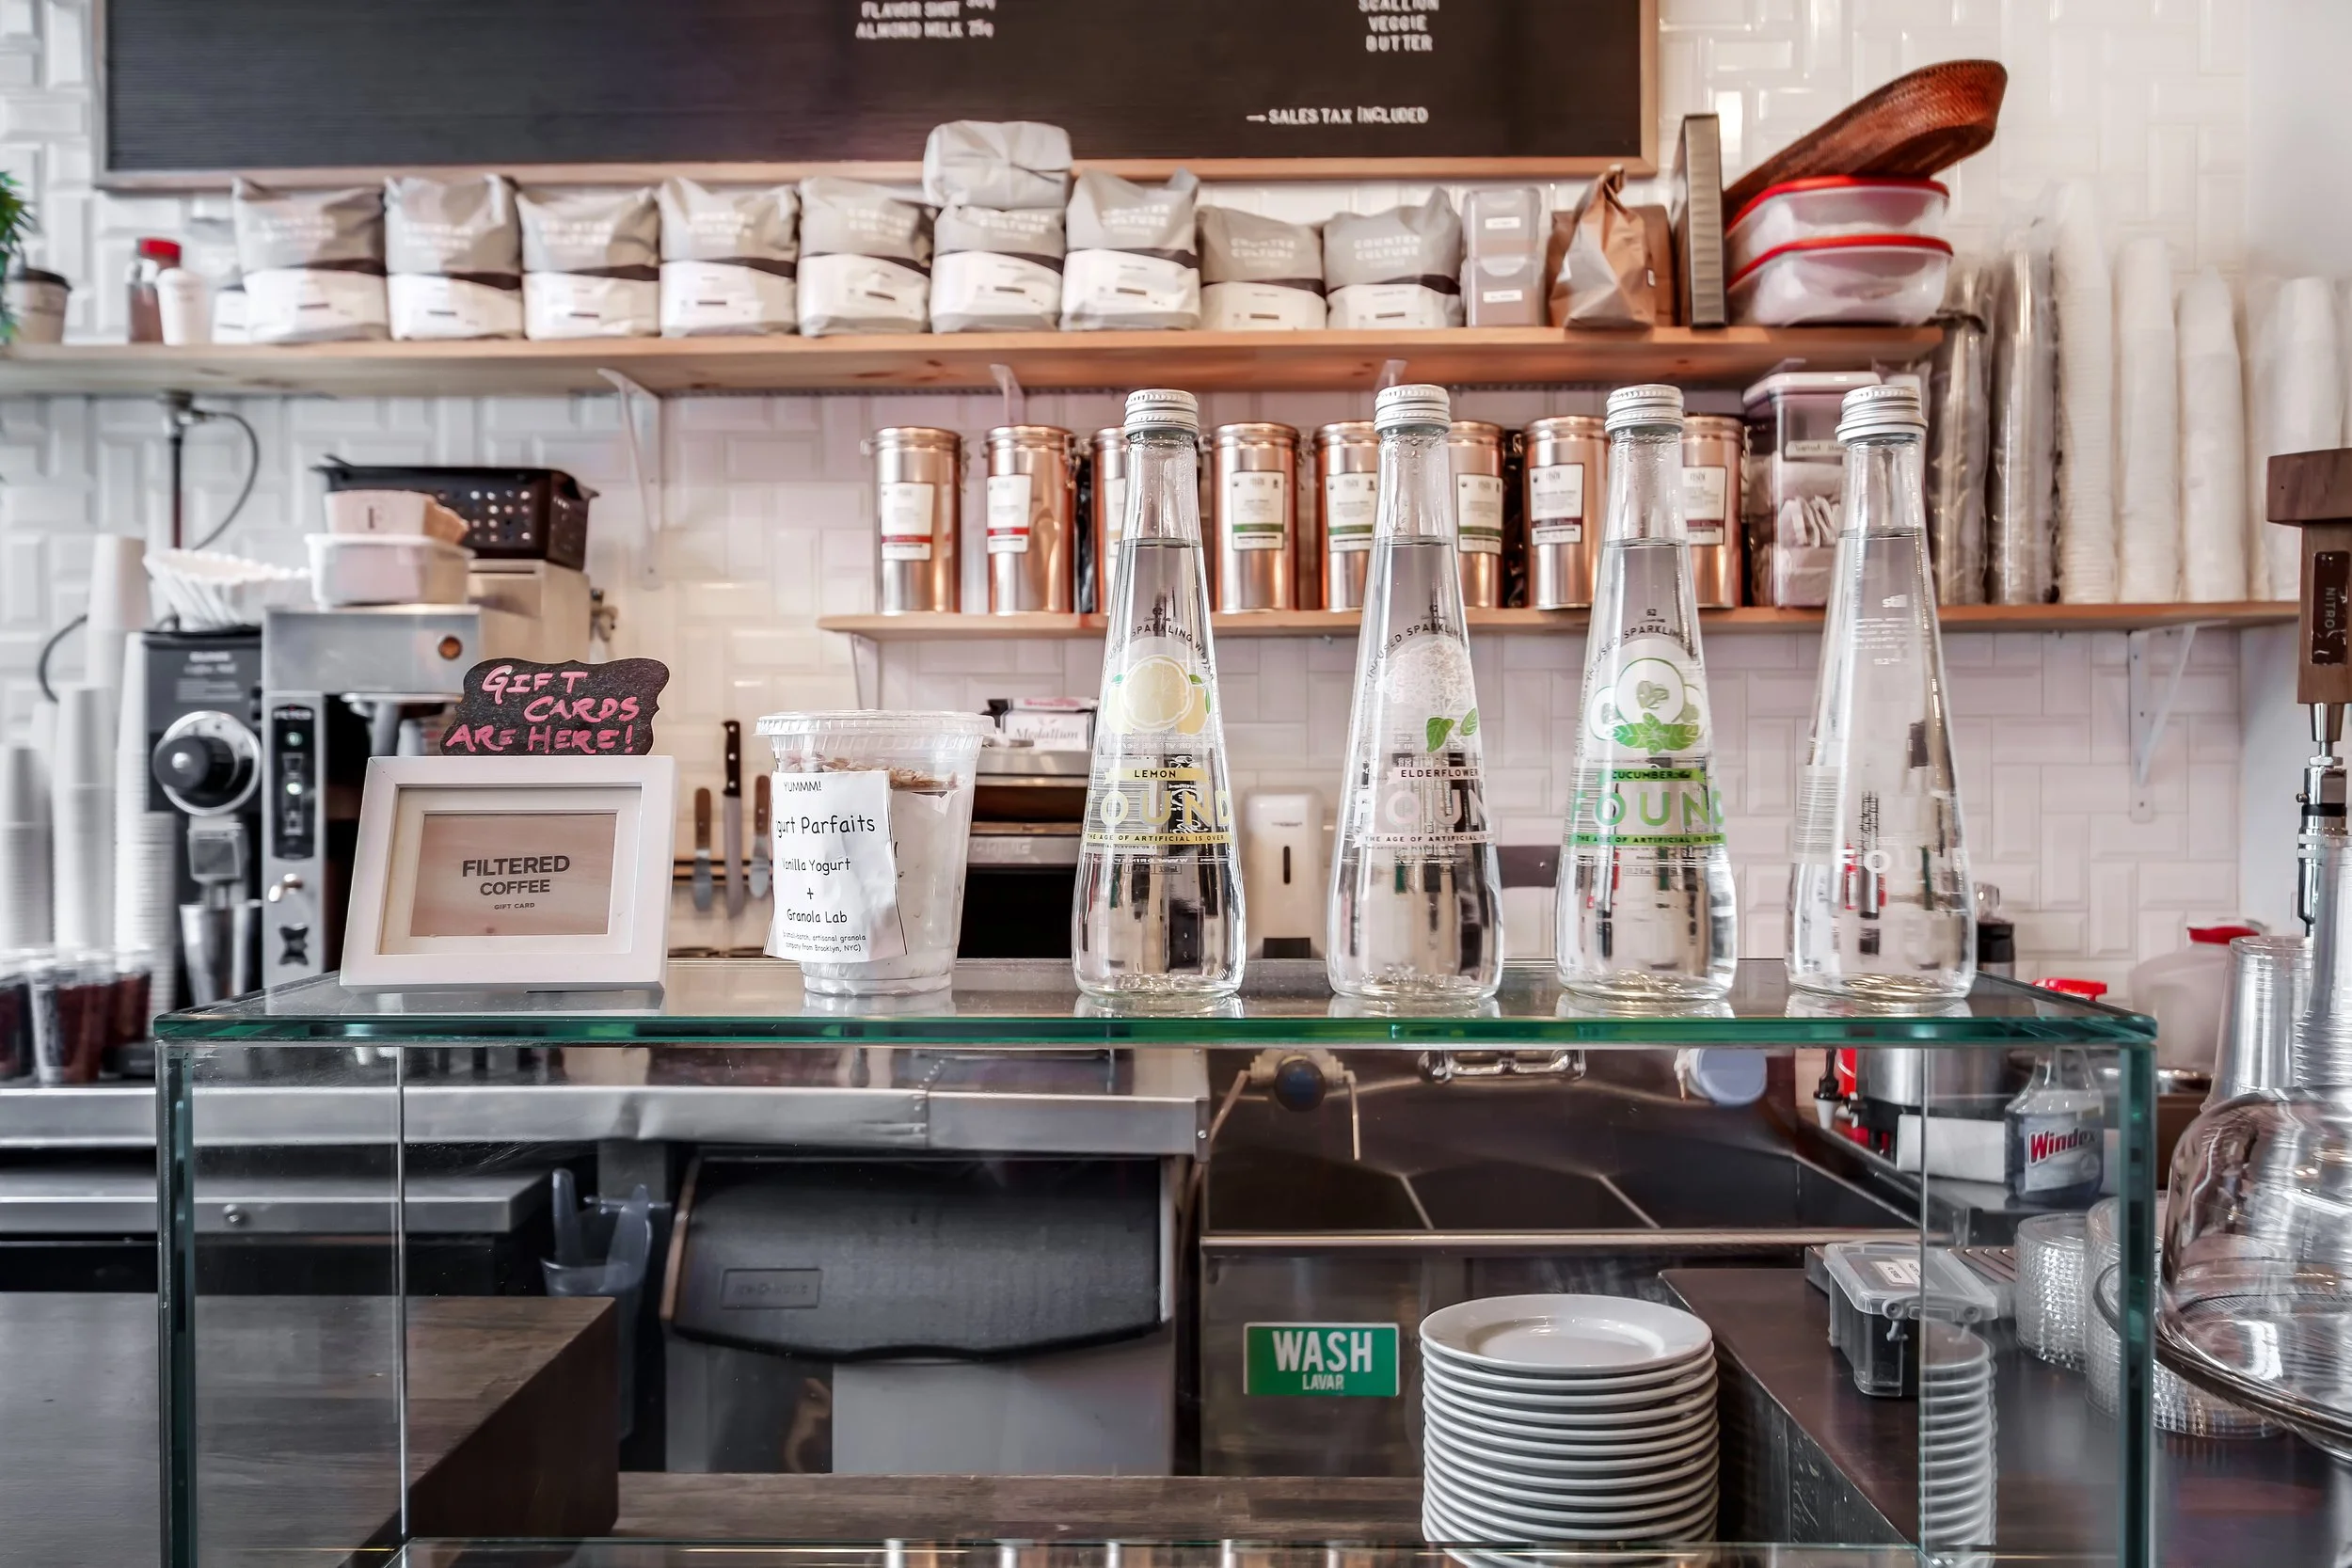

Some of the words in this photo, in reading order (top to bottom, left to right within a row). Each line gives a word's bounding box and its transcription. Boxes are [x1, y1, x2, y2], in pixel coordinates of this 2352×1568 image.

[855, 21, 923, 39] ALMOND
[924, 21, 964, 39] MILK
[1368, 14, 1428, 32] VEGGIE
[1366, 34, 1433, 52] BUTTER
[1268, 107, 1320, 125] SALES
[1320, 107, 1353, 124] TAX
[1357, 105, 1429, 123] INCLUDED
[2325, 587, 2336, 629] NITRO
[482, 665, 589, 705] GIFT
[523, 696, 641, 723] CARDS
[445, 723, 516, 752] ARE
[528, 724, 633, 753] HERE!
[1134, 769, 1176, 778] LEMON
[1401, 768, 1479, 778] ELDERFLOWER
[1612, 770, 1674, 780] CUCUMBER
[783, 781, 822, 792] YUMMM!
[801, 815, 875, 834] Parfaits
[462, 855, 570, 878] FILTERED
[782, 858, 806, 871] Vanilla
[809, 858, 851, 876] Yogurt
[480, 879, 550, 896] COFFEE
[787, 909, 820, 924] Granola
[824, 910, 848, 924] Lab
[839, 933, 866, 943] granola
[802, 942, 814, 951] from
[814, 944, 842, 954] Brooklyn,
[843, 943, 861, 952] NYC)
[2029, 1126, 2096, 1164] Windex
[1271, 1329, 1373, 1373] WASH
[1301, 1373, 1344, 1391] LAVAR
